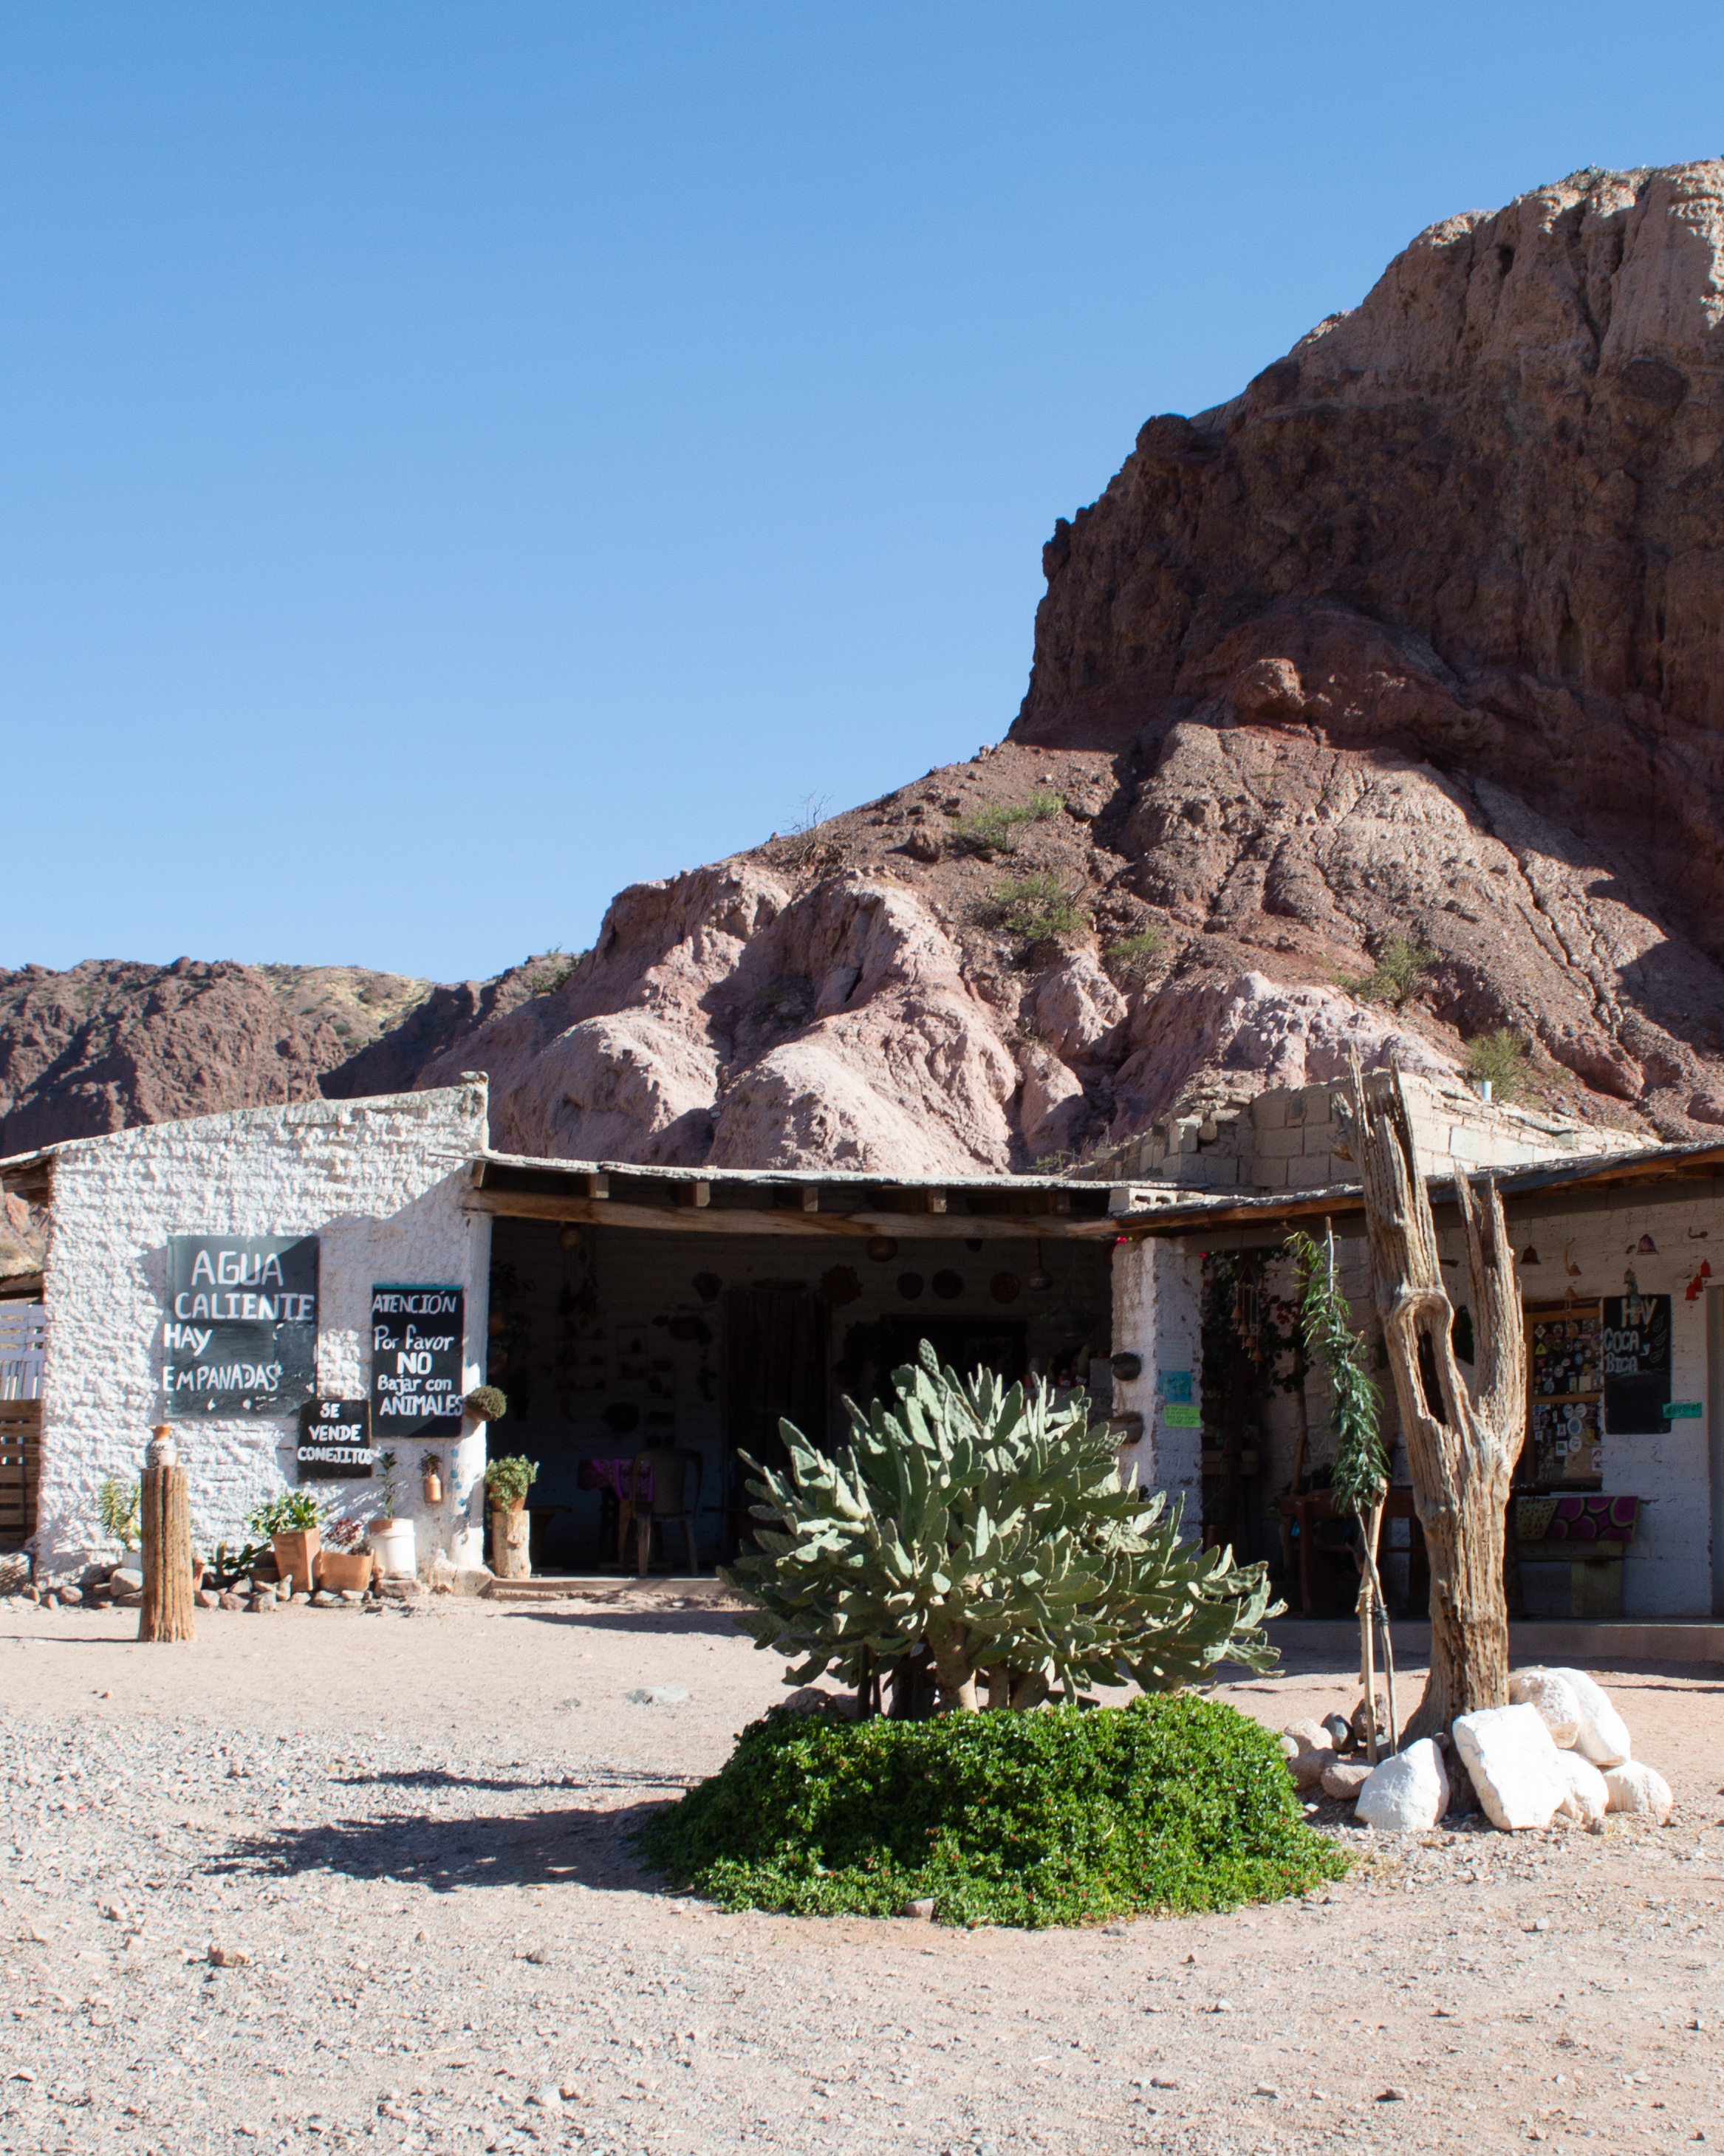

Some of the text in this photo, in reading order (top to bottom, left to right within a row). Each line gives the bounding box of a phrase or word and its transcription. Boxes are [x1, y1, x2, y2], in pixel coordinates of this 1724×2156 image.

[191, 1249, 284, 1287] AGUA
[174, 1292, 315, 1321] CALIENTE
[372, 1290, 456, 1314] ATENCIÓN
[163, 1323, 213, 1356] HAY
[373, 1324, 454, 1351] Por favor
[1604, 1327, 1640, 1353] COCA
[397, 1352, 432, 1375] NO
[377, 1375, 452, 1395] Bajar con
[320, 1403, 340, 1418] SE
[379, 1394, 463, 1417] ANIMALES
[308, 1425, 362, 1442] VENDE
[297, 1446, 374, 1465] CONEJITOS
